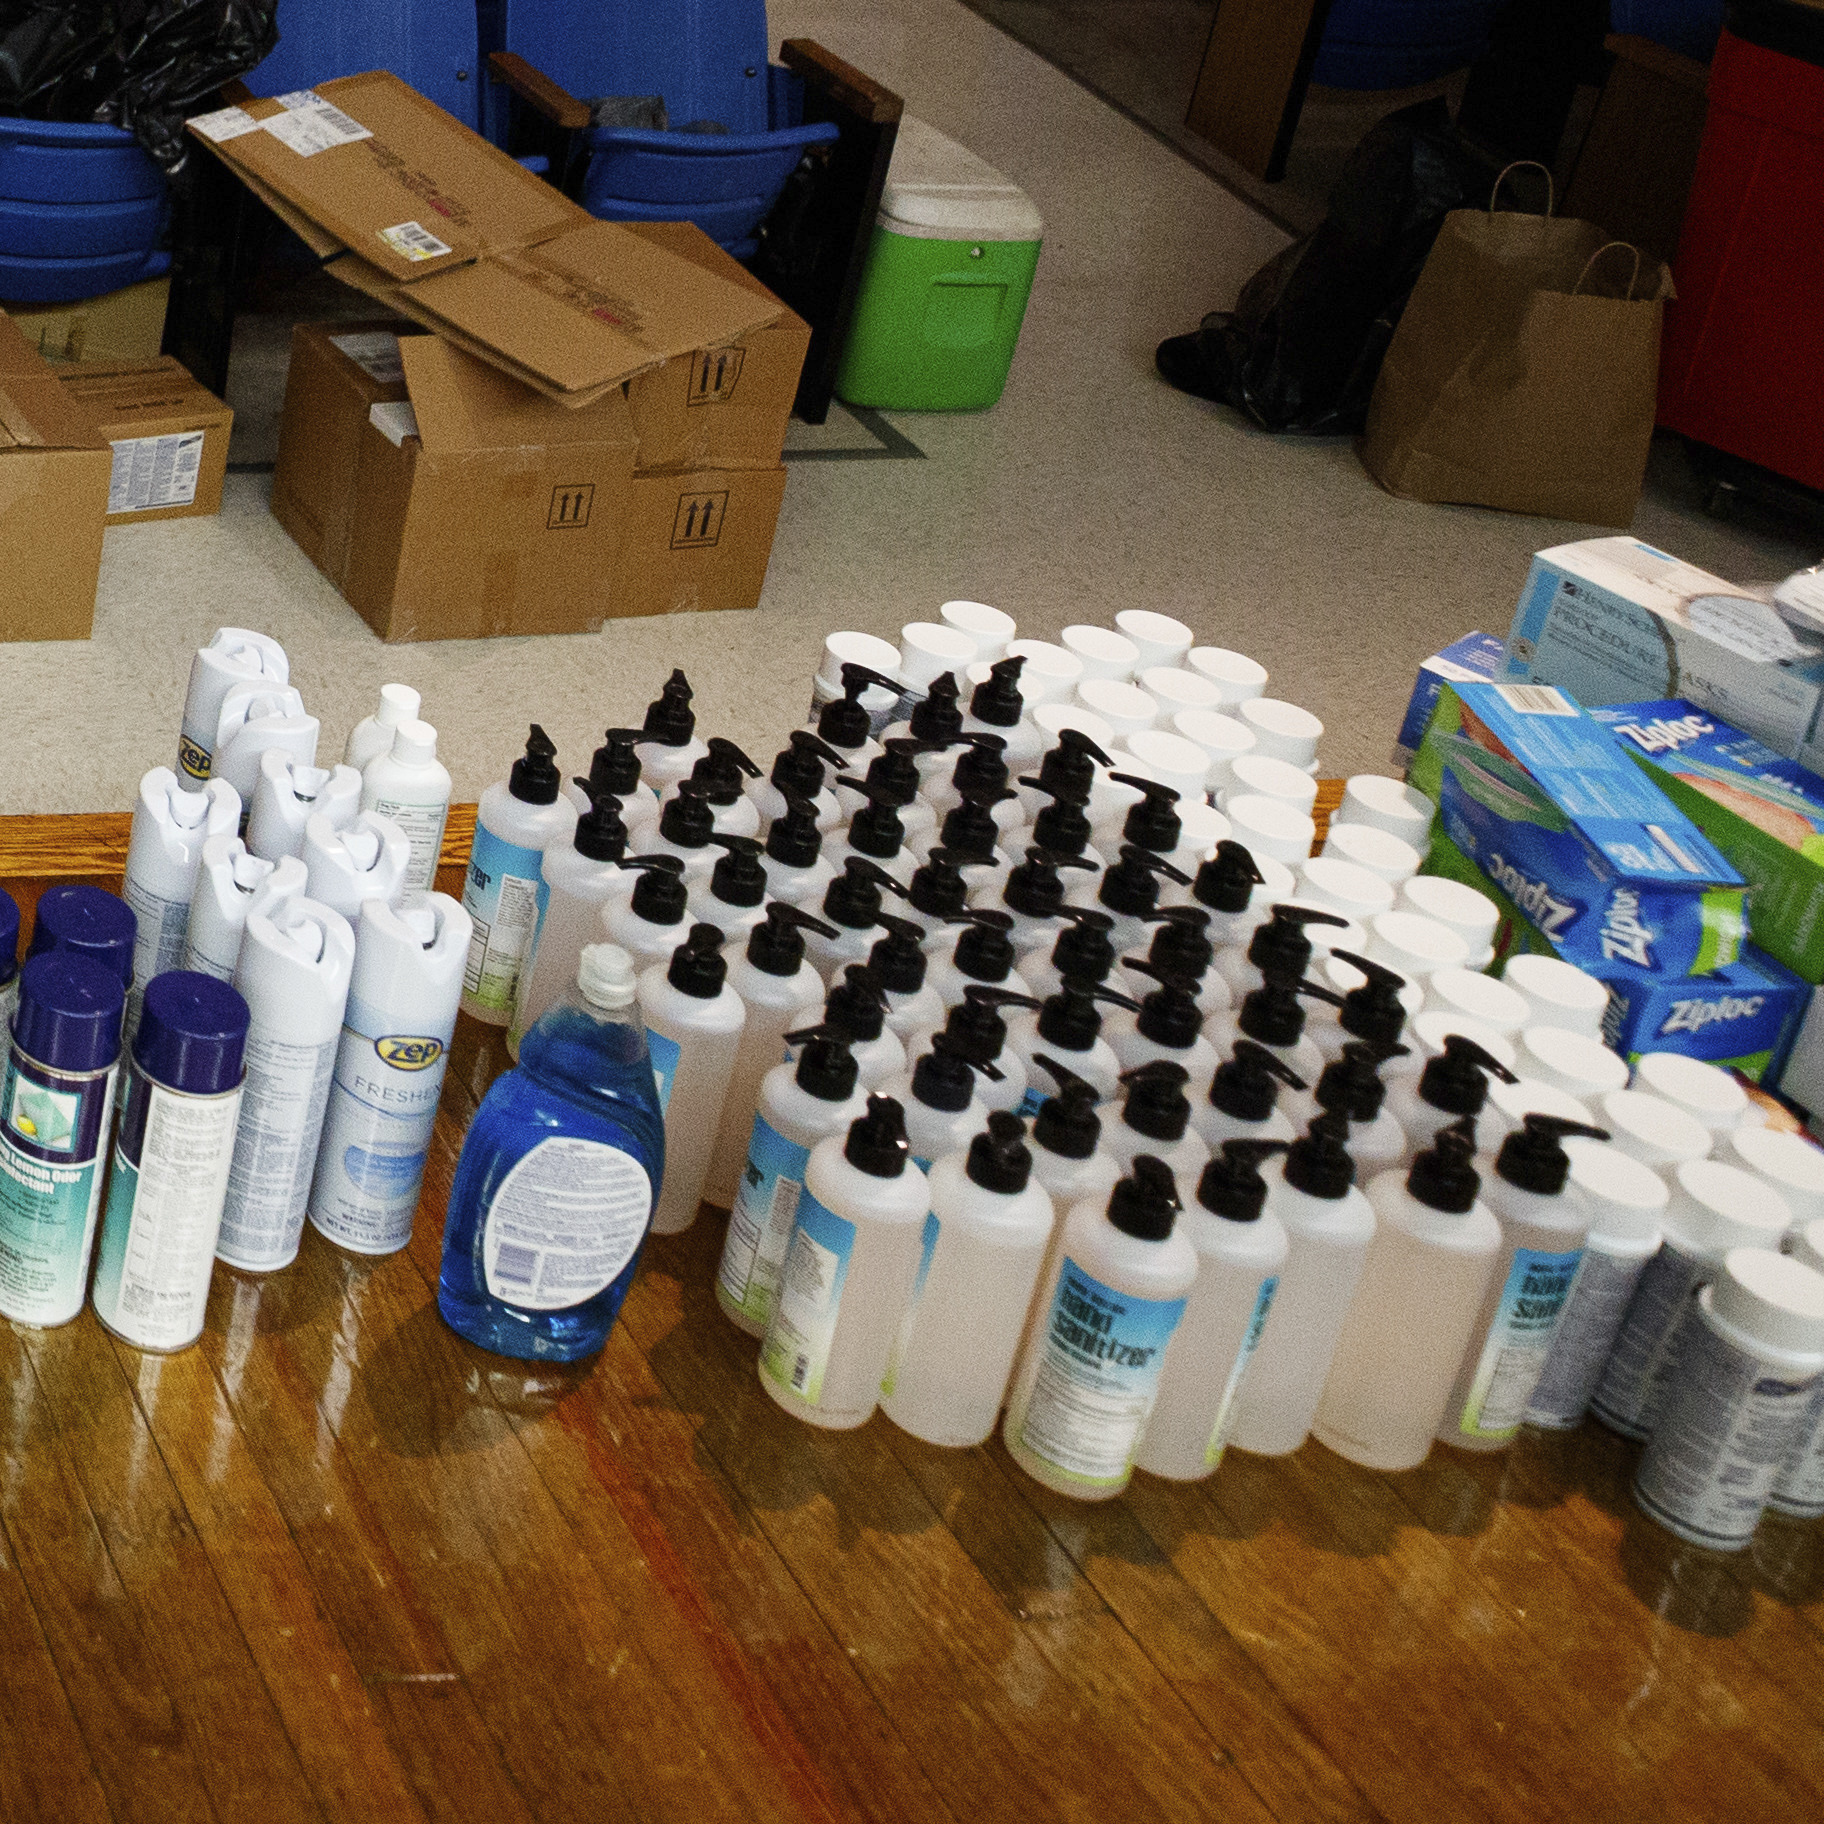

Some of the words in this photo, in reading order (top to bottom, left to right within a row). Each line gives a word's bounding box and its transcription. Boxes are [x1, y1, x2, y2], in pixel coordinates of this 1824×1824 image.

[1614, 715, 1716, 754] Ziploc
[1486, 853, 1578, 943] Ziploc
[1661, 996, 1766, 1035] Ziploc
[386, 1039, 438, 1066] Zep
